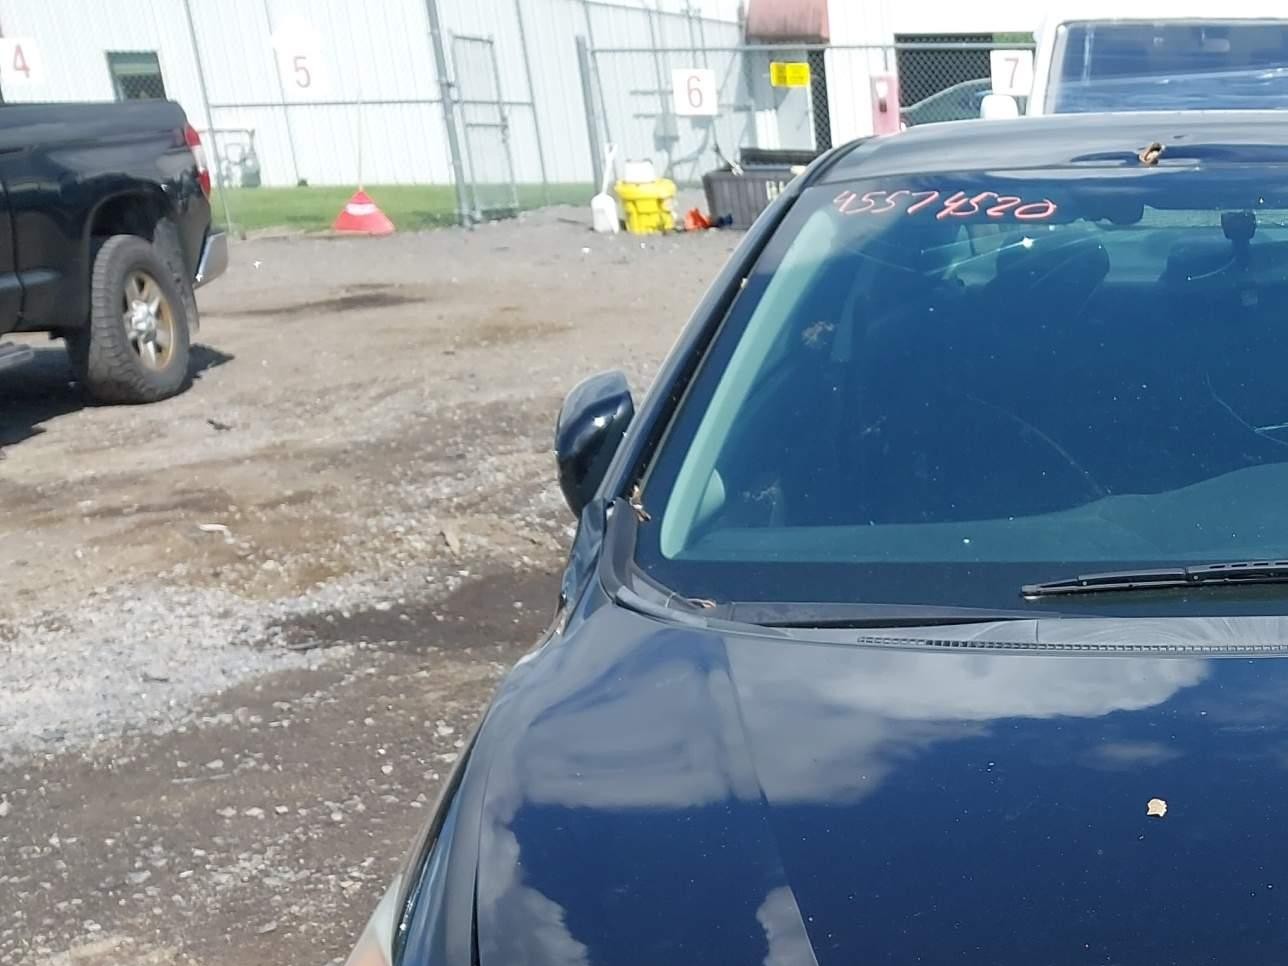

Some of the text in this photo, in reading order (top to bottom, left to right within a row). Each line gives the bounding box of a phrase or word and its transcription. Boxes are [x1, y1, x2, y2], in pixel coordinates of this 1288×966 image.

[12, 44, 31, 79] 4
[293, 55, 311, 88] 5
[1004, 57, 1019, 89] 7
[687, 75, 703, 108] 6
[832, 189, 1058, 220] 45574520
